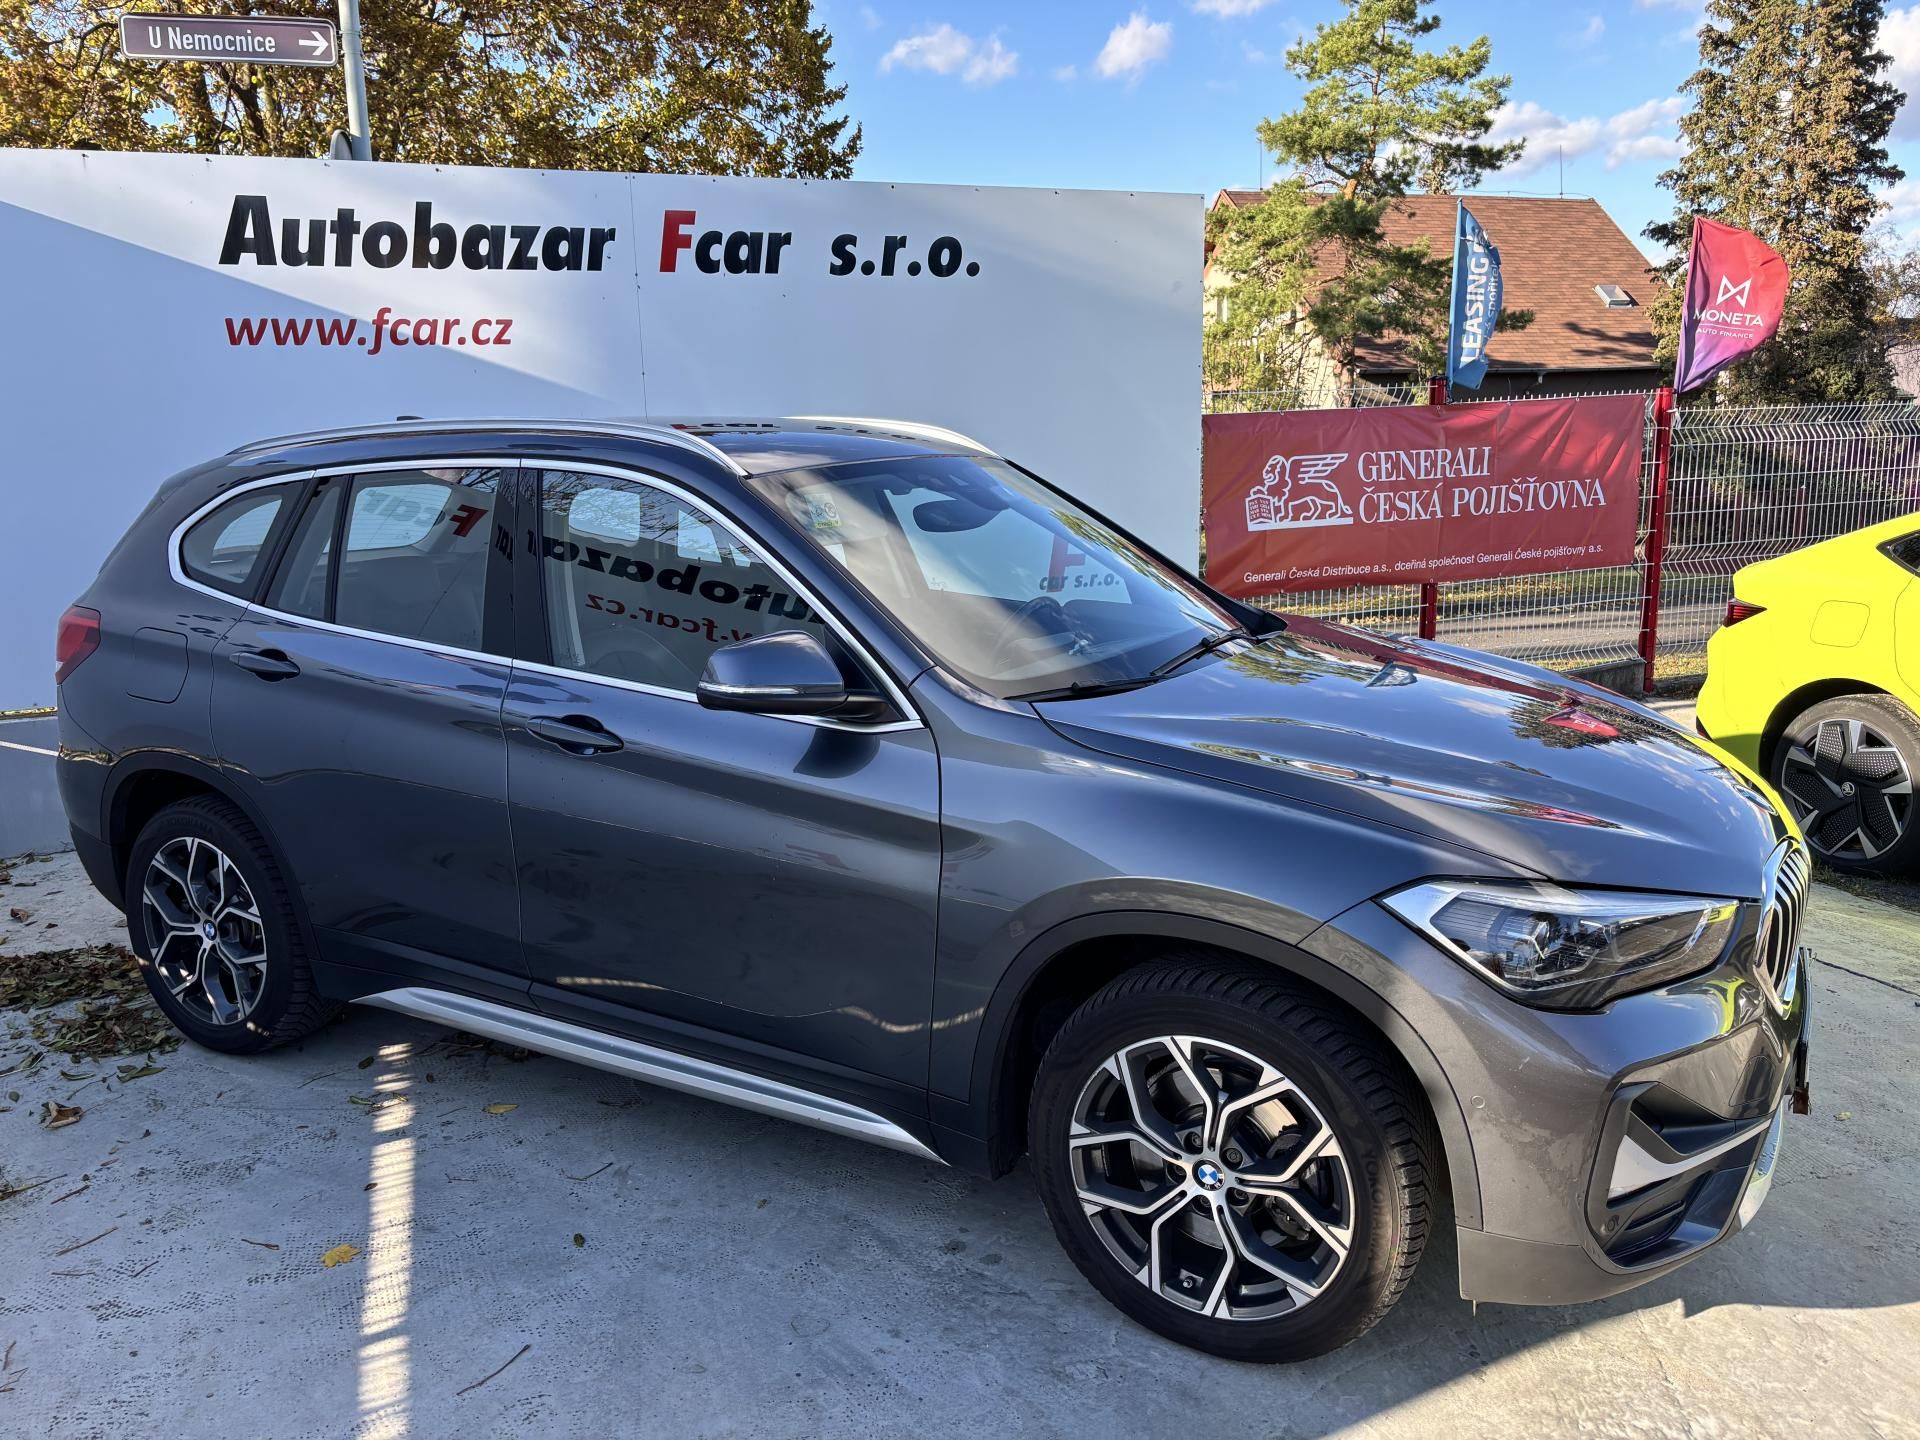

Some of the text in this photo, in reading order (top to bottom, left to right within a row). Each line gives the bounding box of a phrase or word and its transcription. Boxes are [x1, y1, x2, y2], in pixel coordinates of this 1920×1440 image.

[148, 26, 276, 52] U Nemocnice
[219, 194, 980, 277] Autobazar Fcar s.r.o.
[1461, 257, 1490, 364] LEASING
[1693, 308, 1764, 327] MONETA
[225, 307, 512, 355] www.fcar.cz
[1696, 327, 1753, 339] AUTO FINANCE
[1358, 446, 1492, 482] GENERALI
[1359, 476, 1606, 524] ČESKÁ POJIŠŤOVNA
[1244, 570, 1286, 583] Generali
[1288, 566, 1320, 579] Česká
[1322, 564, 1371, 577] Distribuce
[1395, 559, 1426, 571] dceřiná
[1428, 554, 1474, 569] společnost
[1477, 551, 1513, 563] Generali
[1515, 547, 1542, 560] České
[1544, 545, 1586, 558] pojišťovny
[1588, 544, 1604, 553] a.s.
